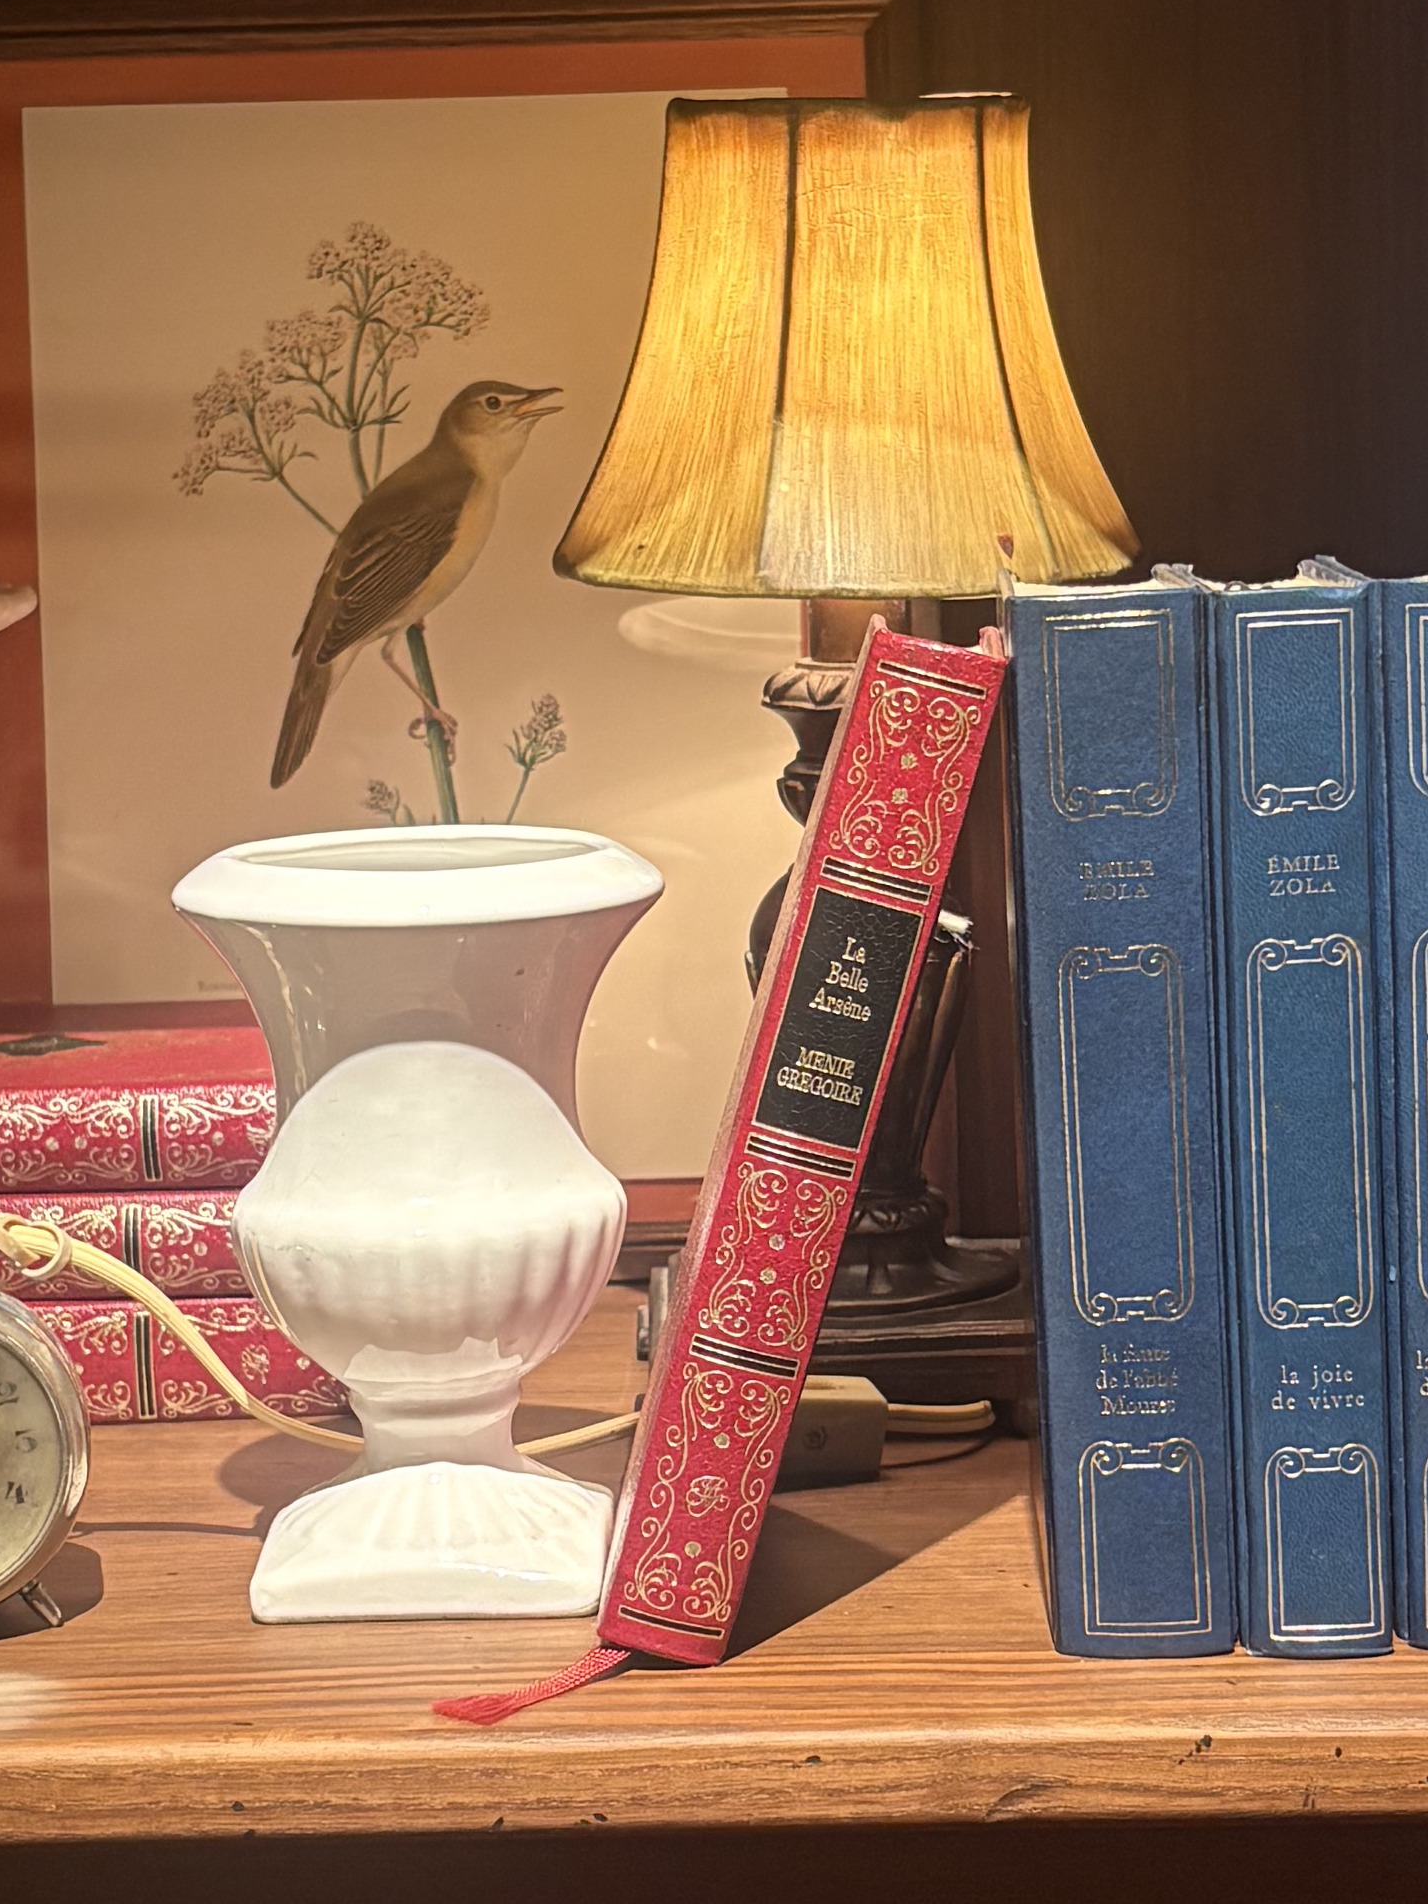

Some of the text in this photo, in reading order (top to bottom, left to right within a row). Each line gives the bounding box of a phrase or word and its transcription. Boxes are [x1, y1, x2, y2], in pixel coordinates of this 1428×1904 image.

[1269, 878, 1336, 897] ZOLA
[841, 936, 866, 965] La
[825, 960, 869, 993] Belle
[808, 987, 871, 1022] Arsène
[1095, 1369, 1119, 1390] de
[1279, 1363, 1354, 1390] la joie
[1272, 1392, 1365, 1412] de vivre
[4, 1480, 28, 1504] 4
